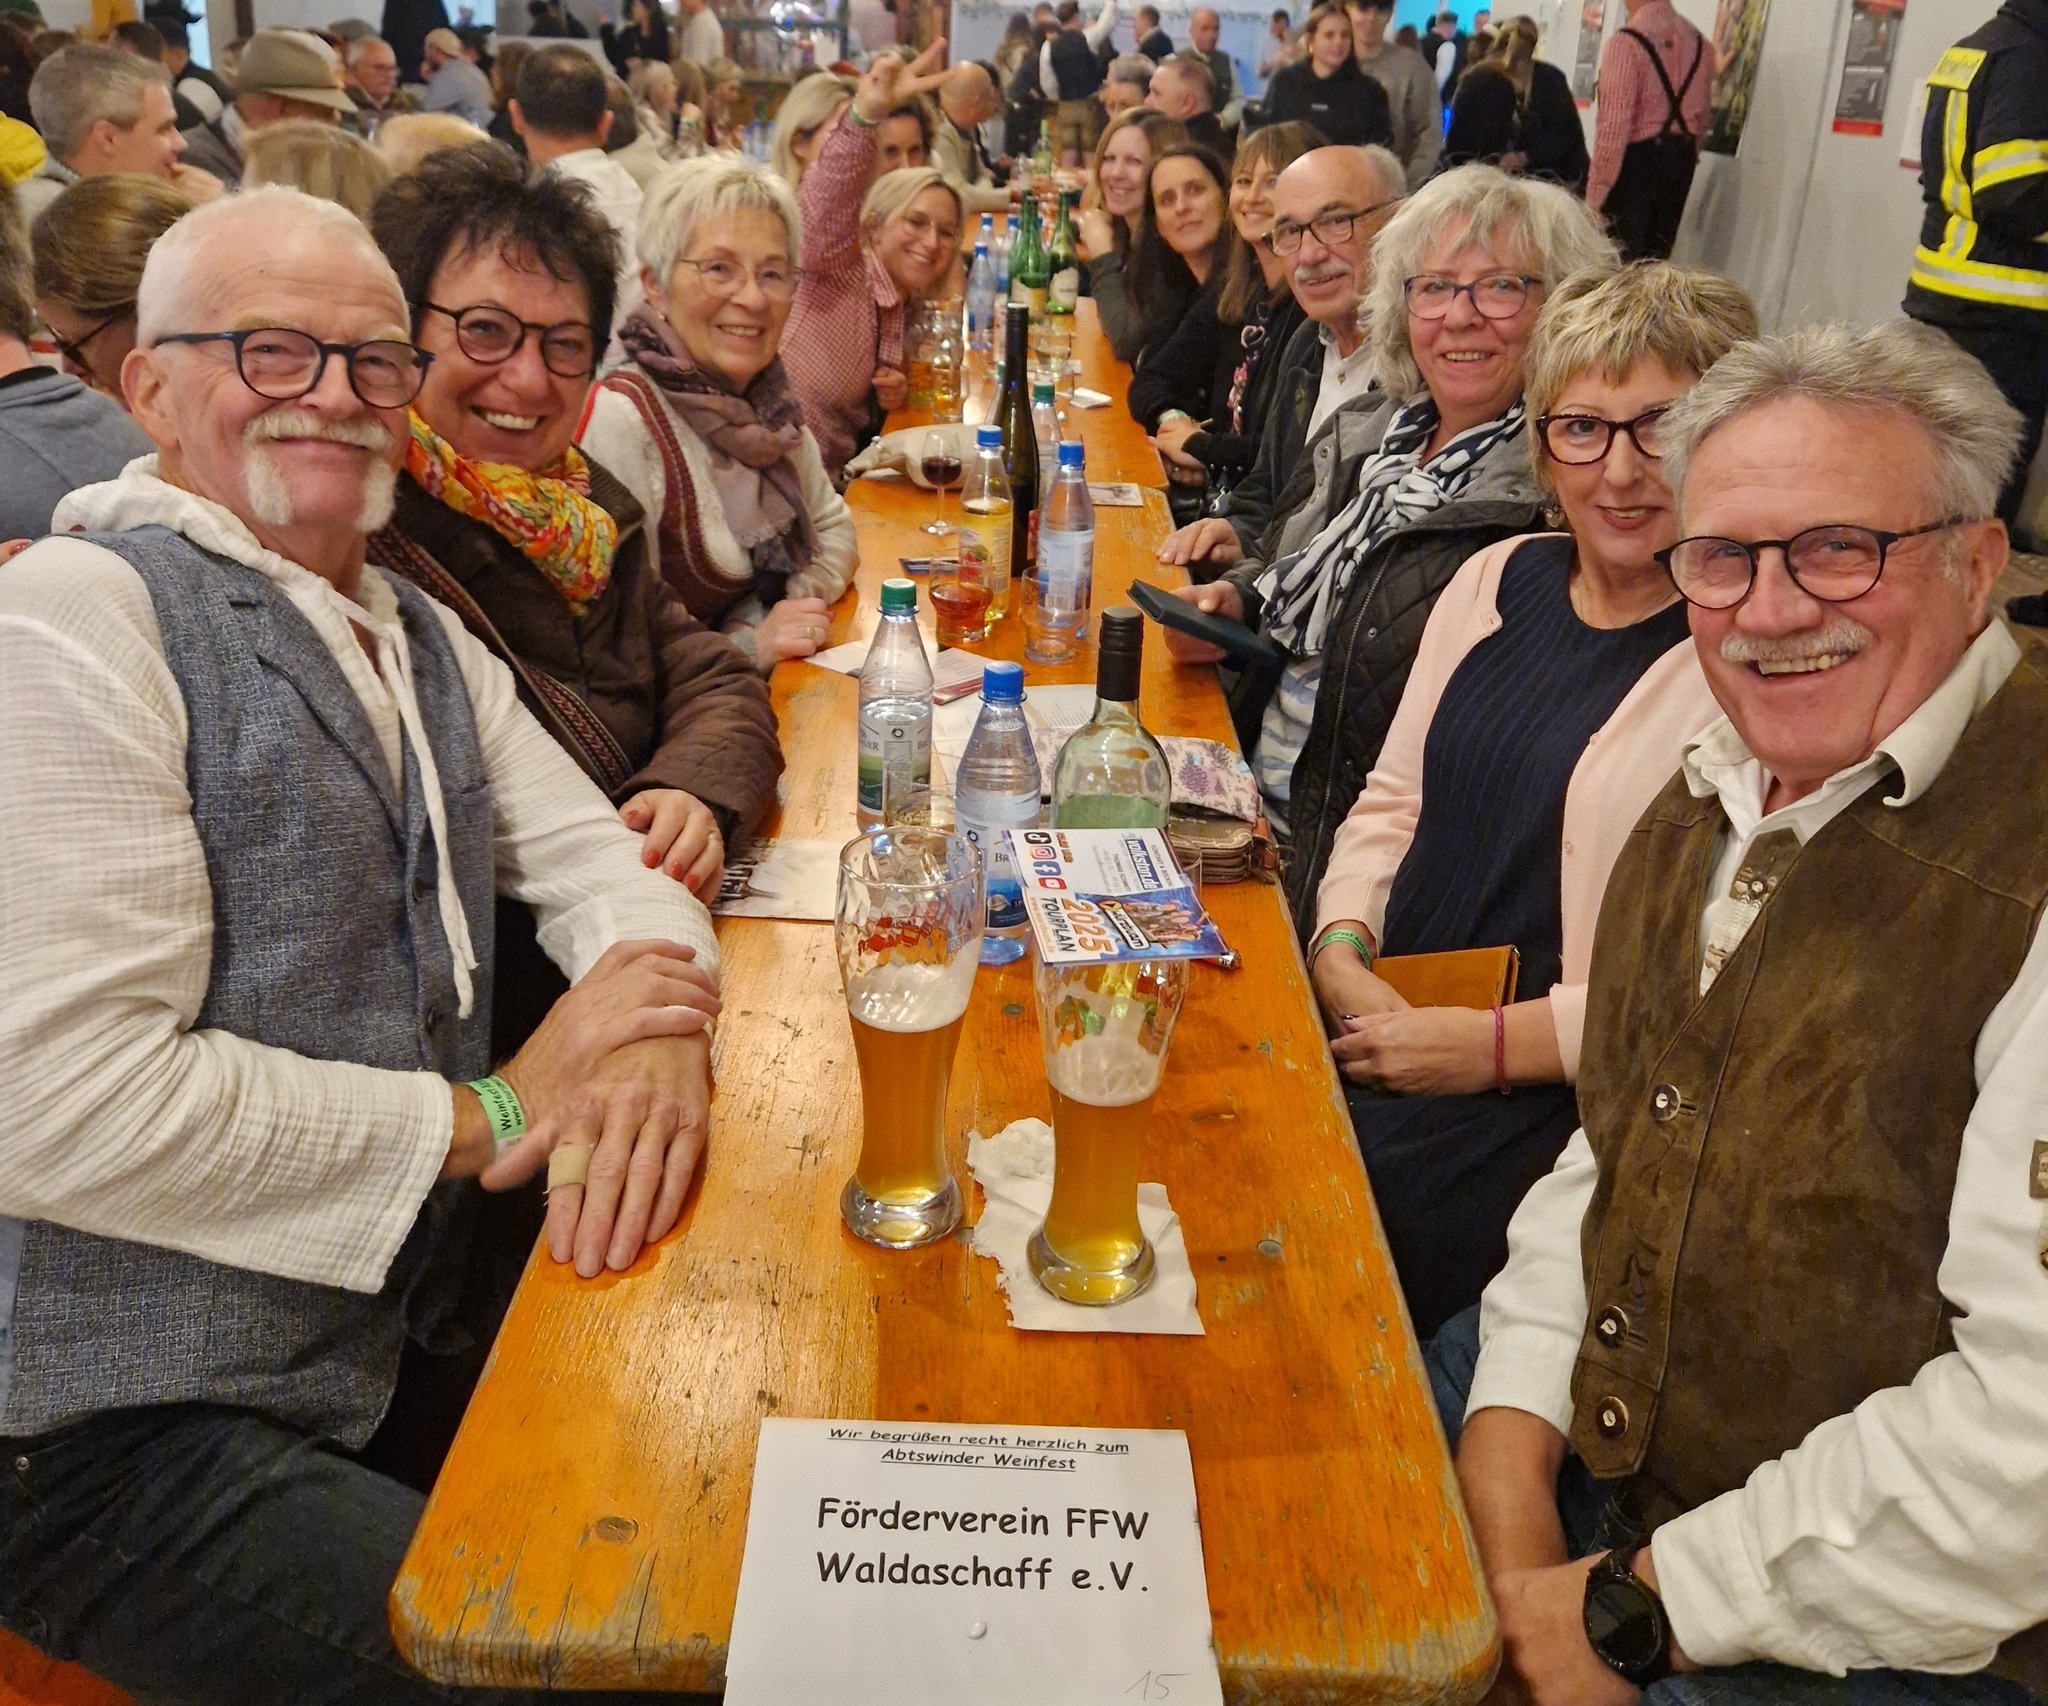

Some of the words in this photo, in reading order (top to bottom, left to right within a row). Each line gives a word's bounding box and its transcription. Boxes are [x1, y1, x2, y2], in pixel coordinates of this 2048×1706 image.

[1126, 840, 1160, 890] volkston.de
[1041, 897, 1077, 953] TOURPLAN
[1060, 897, 1114, 953] 2025
[487, 1088, 513, 1131] Weinfest
[829, 1427, 863, 1440] Wir
[870, 1429, 951, 1444] begrüßen
[958, 1434, 1008, 1447] recht
[1015, 1436, 1087, 1451] herzlich
[1094, 1441, 1130, 1454] zum
[880, 1448, 984, 1465] Abtswinder
[993, 1453, 1077, 1470] Weinfest
[816, 1497, 1050, 1537] Förderverein
[1065, 1508, 1150, 1541] FFW
[816, 1551, 1054, 1591] Waldaschaff
[1071, 1560, 1150, 1592] e.V.
[1124, 1670, 1194, 1702] 15
